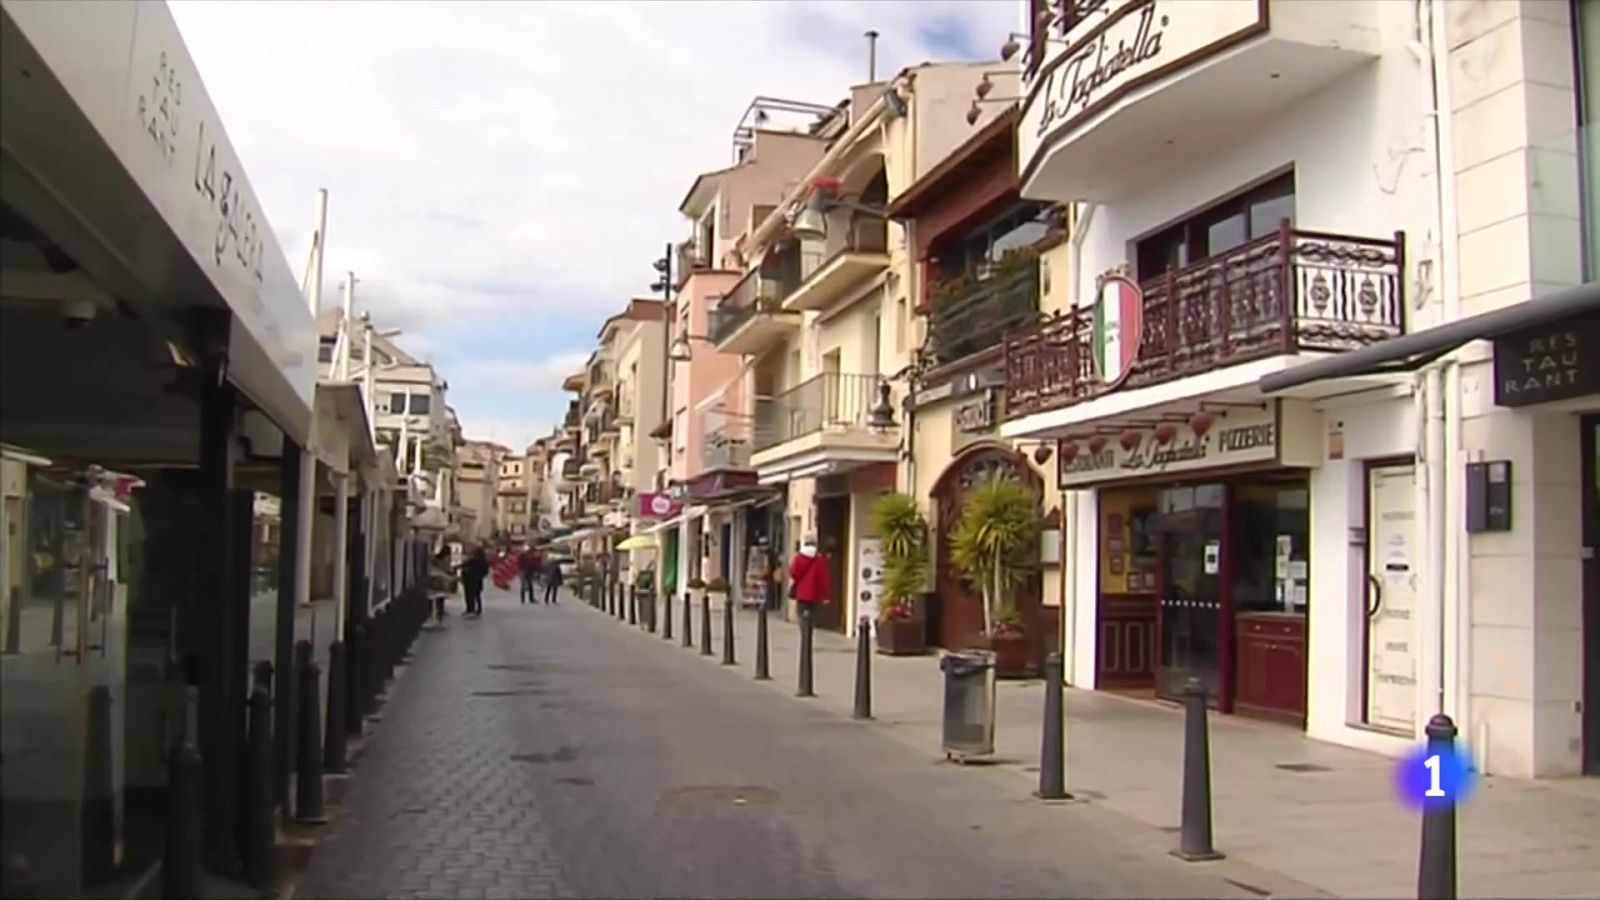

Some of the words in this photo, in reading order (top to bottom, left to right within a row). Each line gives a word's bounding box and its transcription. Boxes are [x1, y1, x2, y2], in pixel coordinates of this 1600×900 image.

[1057, 3, 1163, 119] Tagliatella
[1529, 332, 1577, 354] RES
[1522, 352, 1578, 373] TAU
[1505, 369, 1578, 394] RANT
